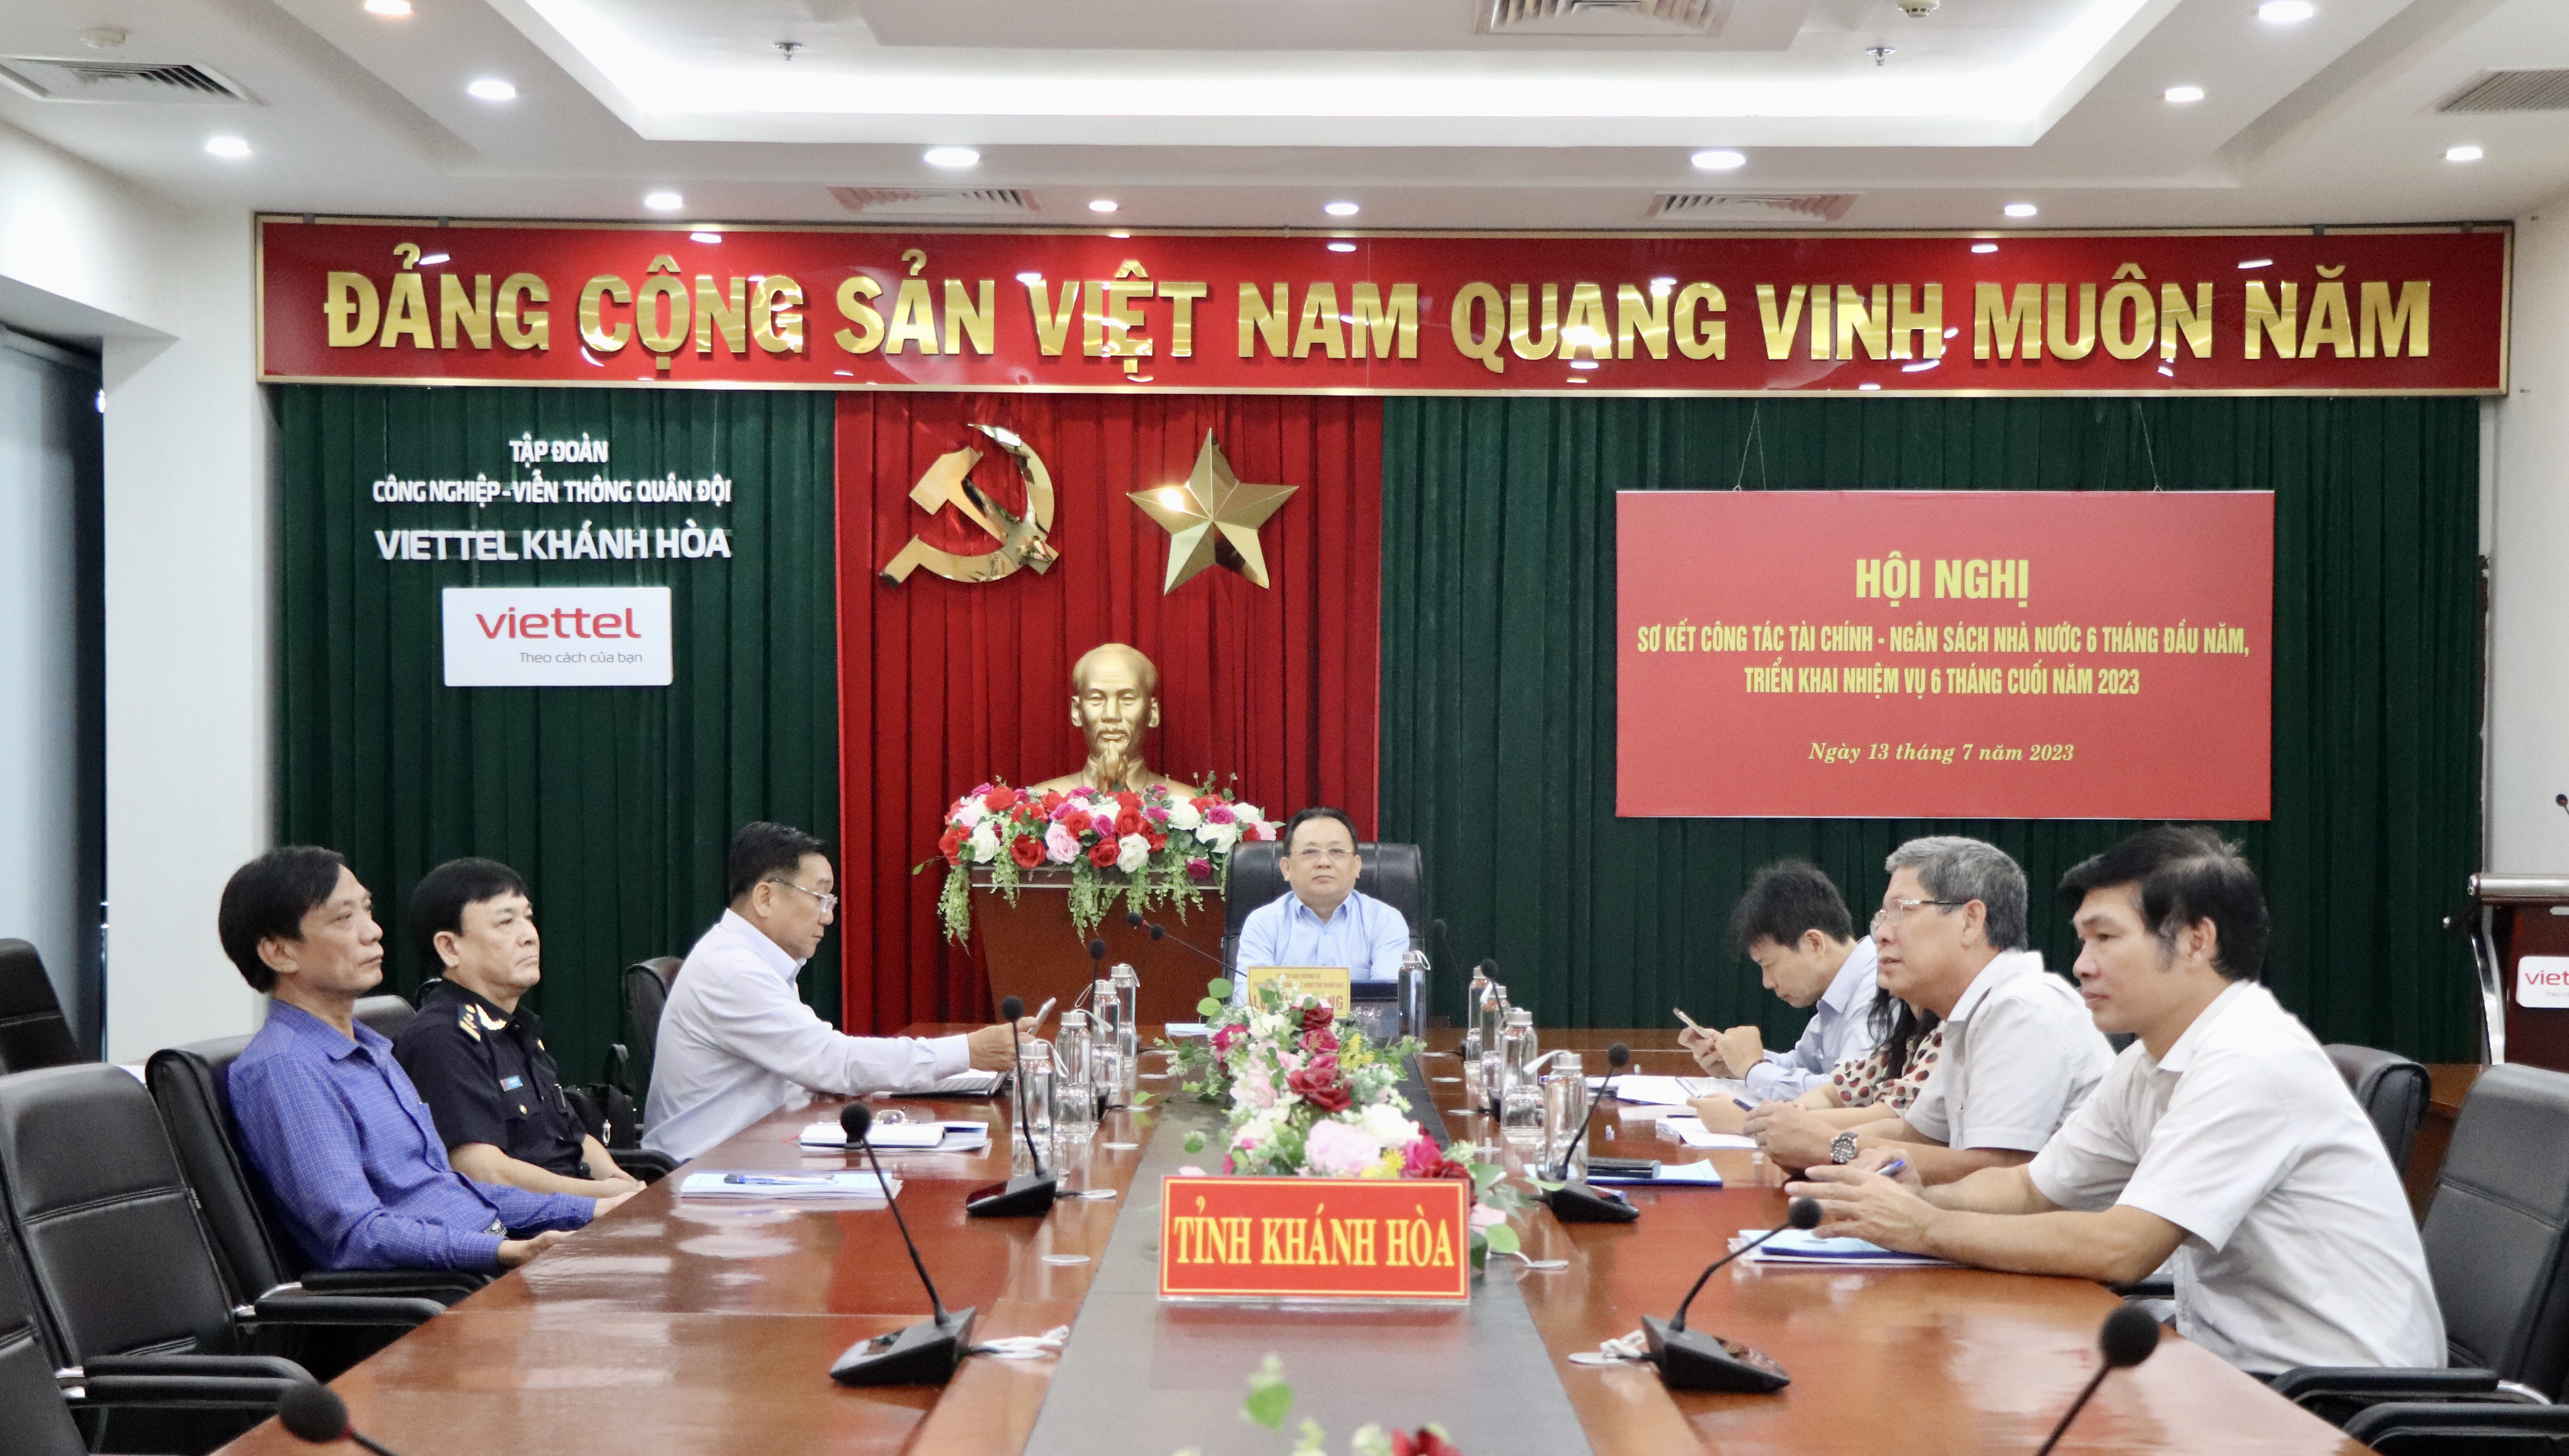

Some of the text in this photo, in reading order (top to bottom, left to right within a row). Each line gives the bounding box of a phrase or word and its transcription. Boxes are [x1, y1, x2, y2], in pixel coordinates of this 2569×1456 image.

[324, 243, 2430, 373] ĐẢNG CỘNG SẢN VIỆT NAM QUANG VINH MUÔN NĂM
[509, 432, 609, 468] TẬP ĐOÀN
[373, 474, 426, 503] CÔNG
[564, 474, 632, 503] THÔNG
[637, 472, 692, 502] QUÂN
[697, 473, 731, 507] ĐỘI
[375, 518, 731, 560] VIETTEL KHÁNH HÒA
[1856, 550, 2029, 608] HỘI NGHỊ
[476, 607, 641, 639] viettel
[1638, 623, 1662, 652] SƠ
[1665, 618, 1696, 652] KẾT
[1701, 621, 1747, 652] CÔNG
[1752, 620, 1785, 651] TÁC
[1789, 620, 1816, 651] TÀI
[1820, 620, 1874, 652] CHÍNH
[1890, 621, 1939, 652] NGÂN
[1943, 621, 1989, 652] SÁCH
[1994, 621, 2030, 652] NHÀ
[2035, 621, 2082, 653] NƯỚC
[2087, 626, 2097, 653] 6
[2103, 622, 2159, 653] THÁNG
[2163, 618, 2199, 654] ĐẦU
[2204, 623, 2250, 657] NĂM,
[520, 651, 643, 664] Theo cách của bạn
[1744, 657, 2140, 699] TRIỂN KHAI NHIỆM VỤ 6 THÁNG CUỐI NĂM 2023
[1809, 742, 2075, 765] Ngày 13 tháng 7 năm 2023
[1174, 1196, 1455, 1267] TỈNH KHÁNH HÒA
